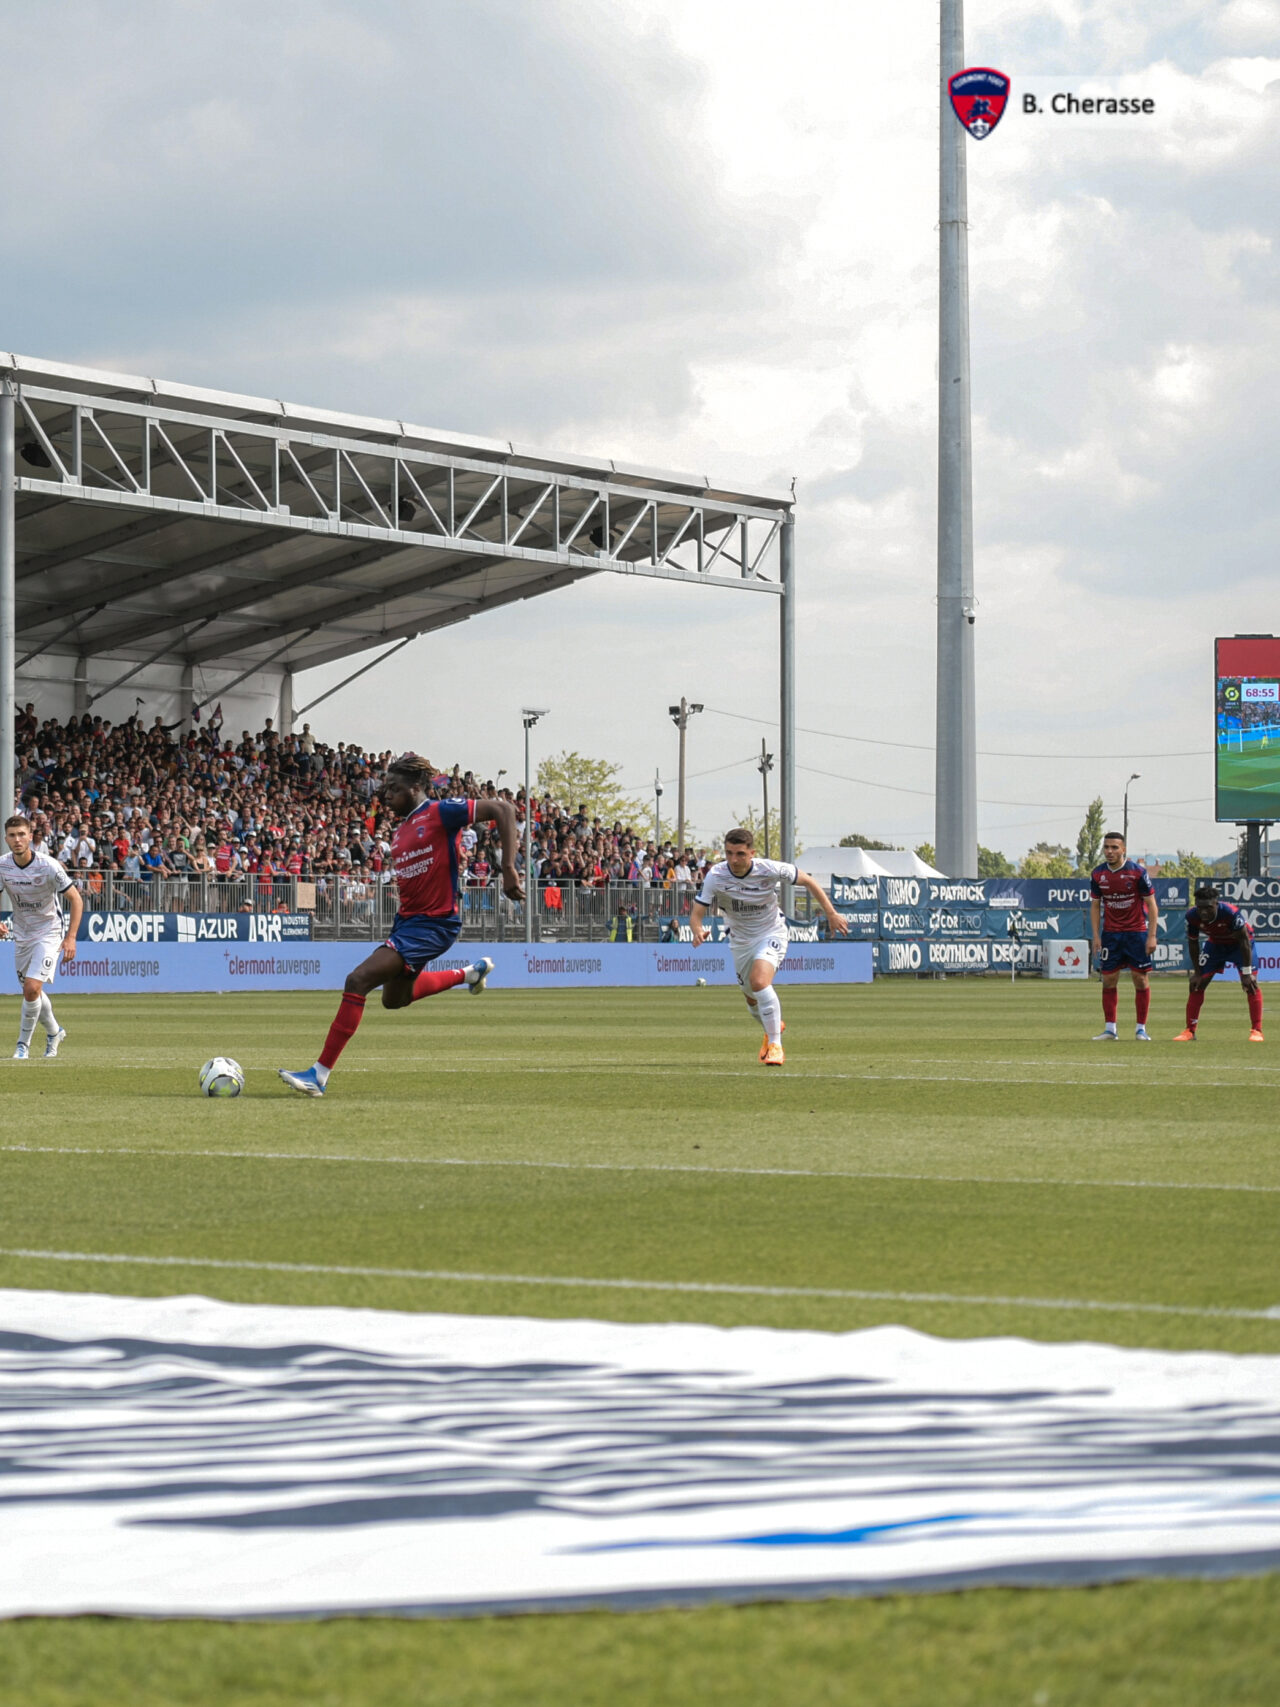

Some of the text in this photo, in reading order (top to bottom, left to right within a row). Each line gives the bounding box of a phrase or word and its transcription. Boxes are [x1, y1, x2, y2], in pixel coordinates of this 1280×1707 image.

[1245, 688, 1275, 697] 68:55
[844, 884, 877, 900] PATRICK
[940, 885, 986, 901] PATRICK
[1048, 889, 1093, 901] PUY-D
[88, 913, 165, 942] CAROFF
[198, 918, 238, 939] AZUR
[929, 944, 987, 962] DECATHLON
[60, 957, 160, 977] clermont auvergne
[229, 955, 321, 976] clermont auvergne
[527, 955, 602, 974] clermont auvergne
[657, 955, 725, 973] clermont auvergne
[805, 959, 835, 972] auvergne
